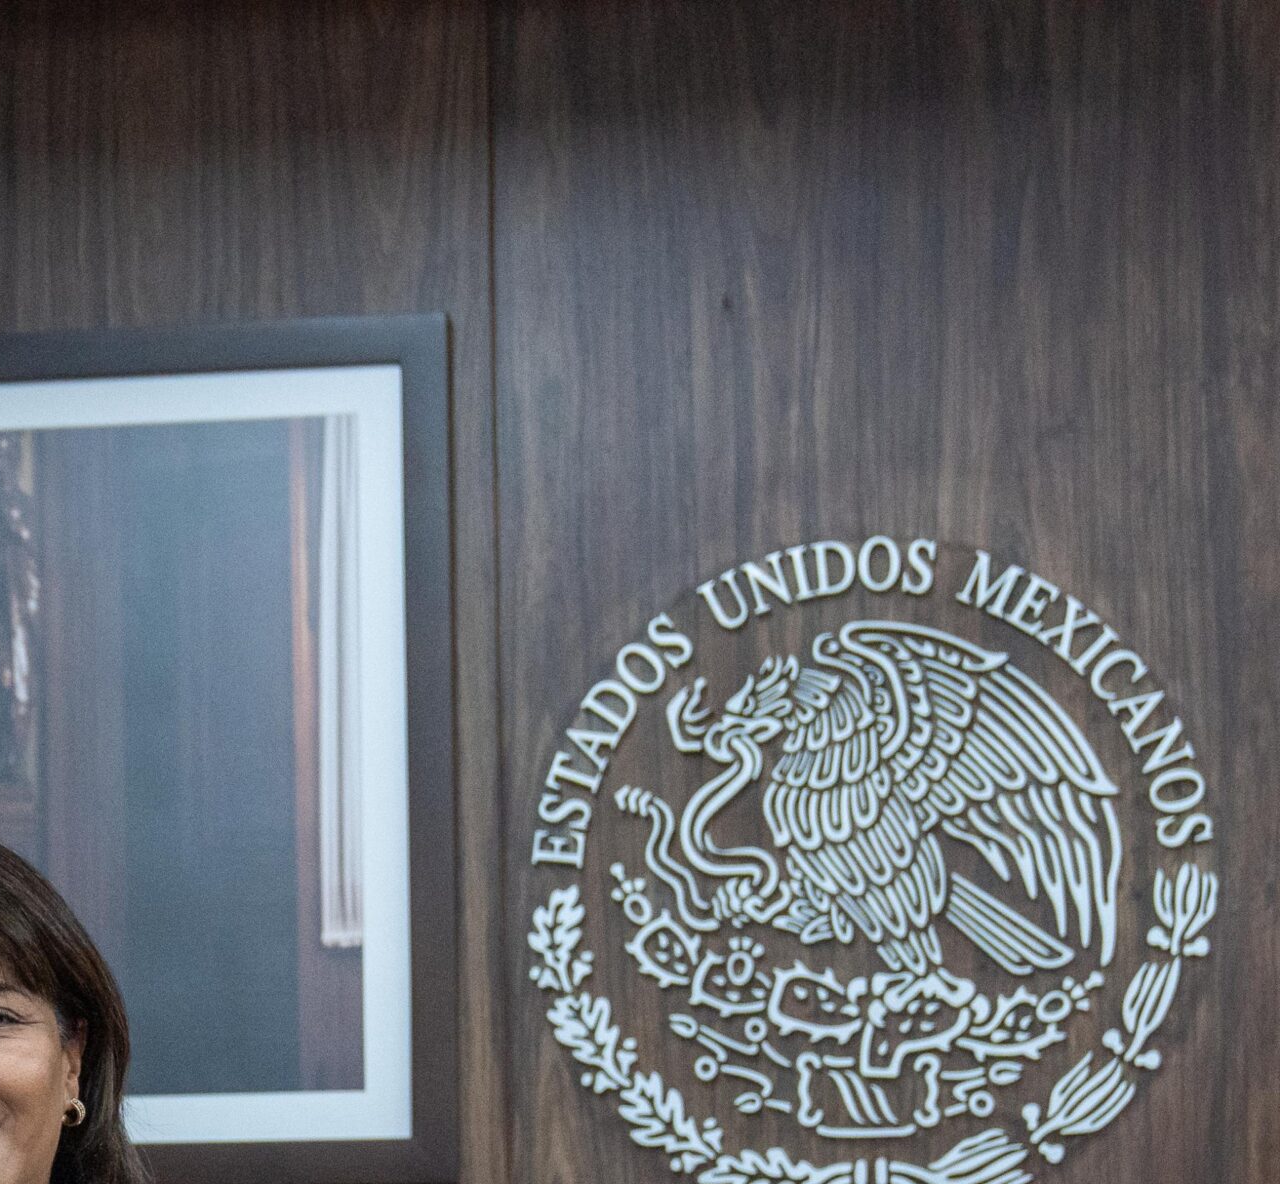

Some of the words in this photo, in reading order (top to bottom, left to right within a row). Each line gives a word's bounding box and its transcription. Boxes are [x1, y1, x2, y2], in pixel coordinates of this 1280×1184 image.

[531, 614, 694, 869] ESTADOS
[697, 535, 937, 630] UNIDOS
[956, 551, 1213, 850] MEXICANOS
